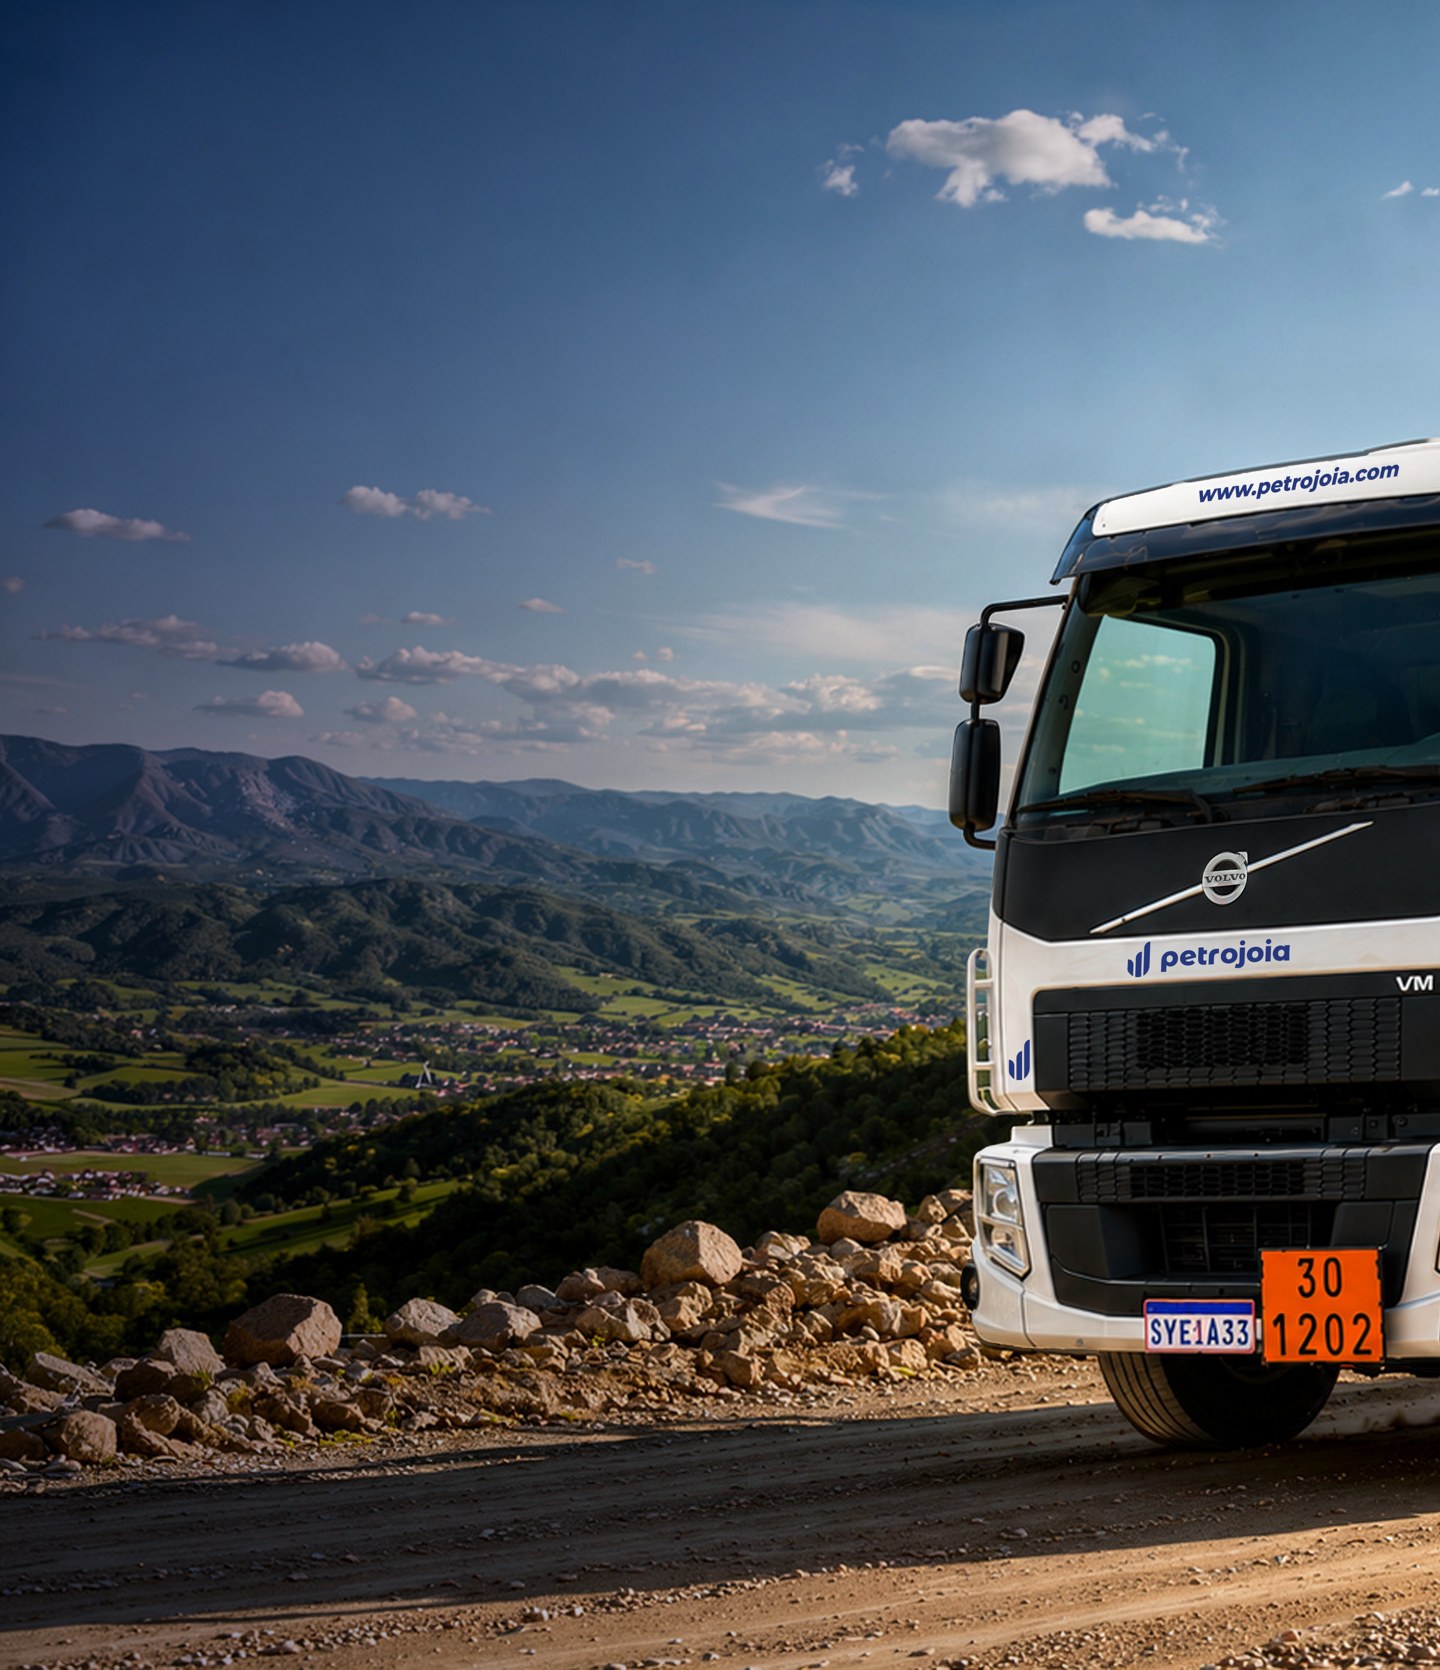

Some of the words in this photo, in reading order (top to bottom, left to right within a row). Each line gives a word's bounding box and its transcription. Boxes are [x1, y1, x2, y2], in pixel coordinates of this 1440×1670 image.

[1198, 464, 1400, 502] www.petrojoia.com
[1204, 872, 1246, 883] VOLVO
[1160, 938, 1290, 973] petrojoia
[1396, 975, 1433, 992] VM
[1298, 1257, 1342, 1298] 30
[1150, 1317, 1249, 1346] SYE1A33
[1273, 1312, 1372, 1356] 1202
